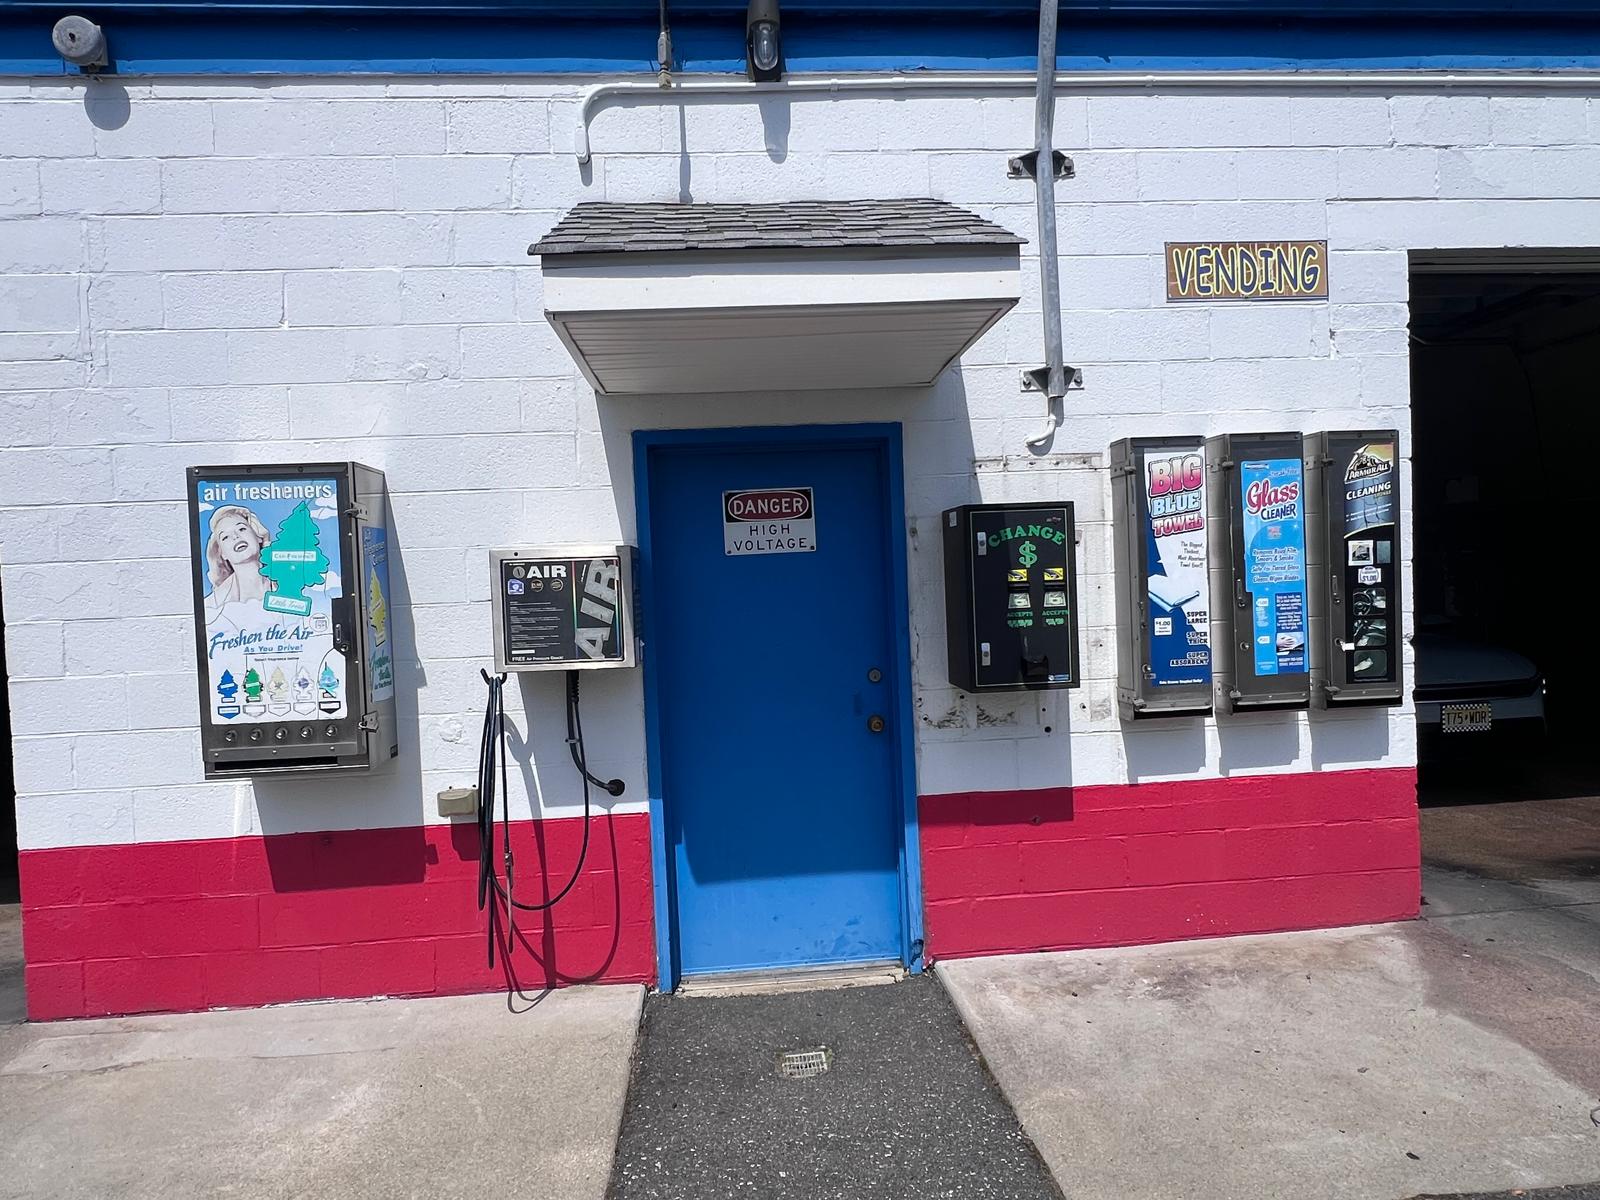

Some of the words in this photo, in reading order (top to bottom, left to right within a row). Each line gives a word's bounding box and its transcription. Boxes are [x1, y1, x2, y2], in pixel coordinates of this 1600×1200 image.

[1173, 245, 1320, 296] VENDING
[1148, 454, 1203, 497] BIG
[203, 484, 227, 501] air
[234, 482, 332, 501] fresheners
[1246, 479, 1299, 514] Glass
[1346, 481, 1392, 501] CLEANING
[733, 497, 803, 515] DANGER
[1150, 490, 1201, 518] BLUE
[1260, 503, 1297, 521] CLEANER
[749, 524, 790, 536] HIGH
[1152, 511, 1204, 538] TOWEL
[733, 537, 807, 551] VOLTAGE
[988, 524, 1065, 547] CHANGE
[526, 564, 567, 579] AIR
[575, 560, 618, 659] AIR
[209, 628, 262, 660] Freshen
[266, 624, 287, 641] the
[288, 625, 314, 641] Air
[277, 644, 303, 652] Drive!
[1446, 711, 1463, 726] T75
